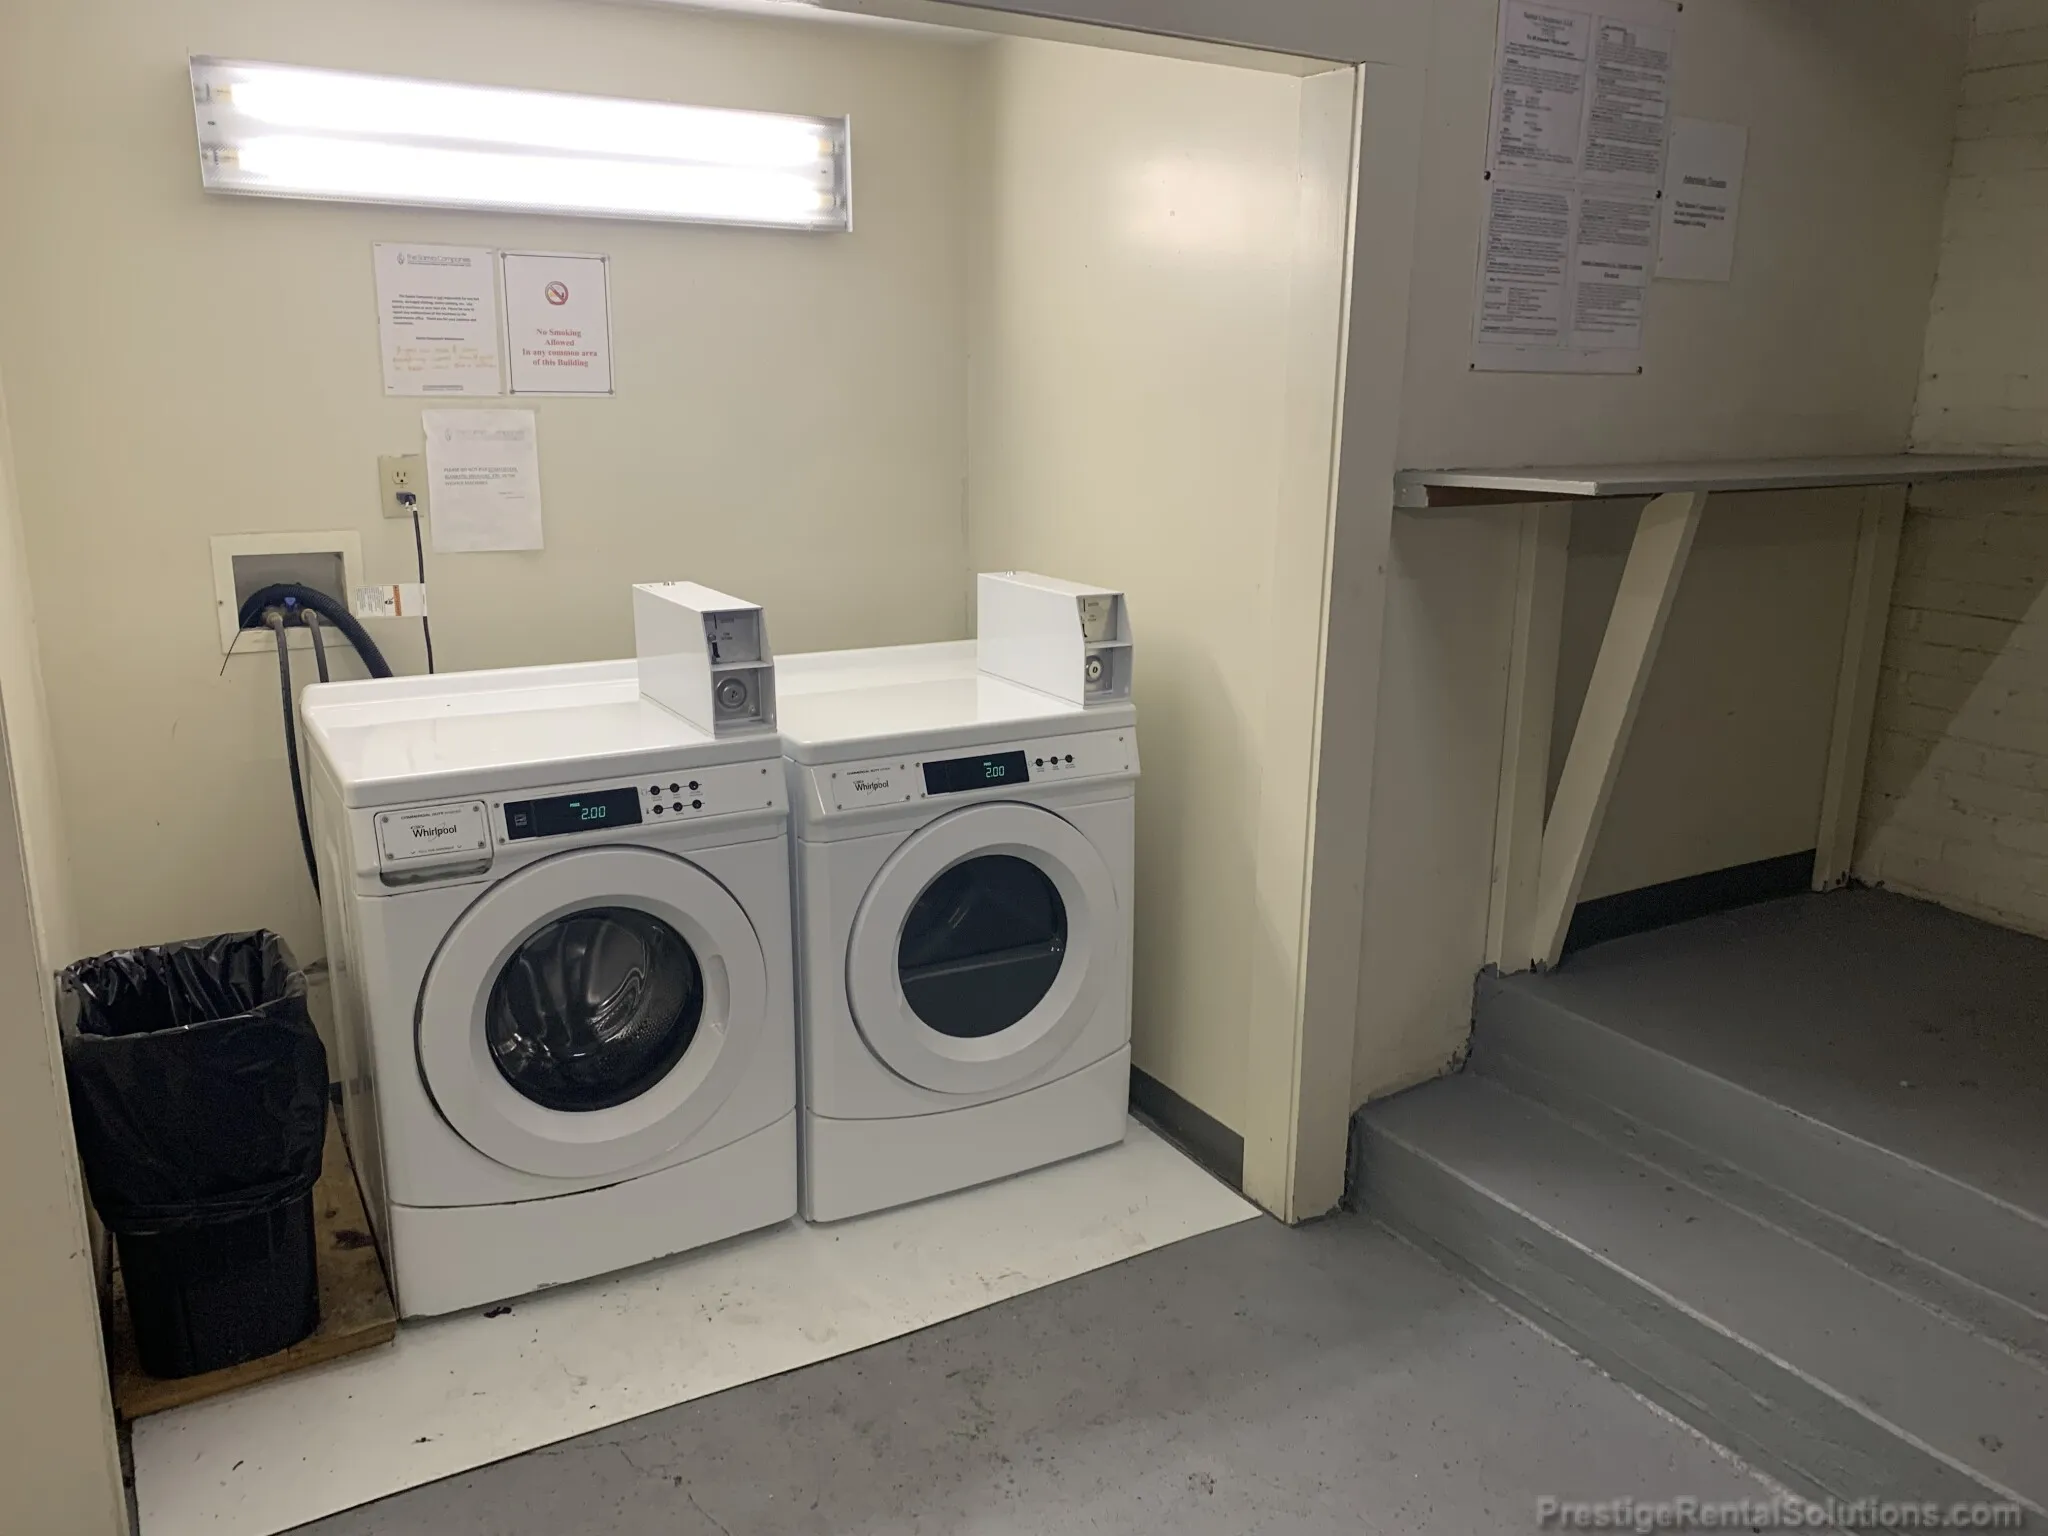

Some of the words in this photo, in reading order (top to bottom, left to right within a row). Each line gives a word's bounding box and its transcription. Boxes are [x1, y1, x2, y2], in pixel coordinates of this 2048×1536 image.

[536, 328, 547, 336] No
[549, 329, 582, 338] Smoking
[544, 339, 575, 347] Allowed
[522, 348, 531, 356] In
[533, 350, 545, 358] any
[557, 359, 589, 368] Building
[985, 765, 1005, 778] 2.00
[855, 780, 889, 792] Whirlpool
[581, 805, 606, 820] 2.00
[412, 824, 457, 838] Whirlpool
